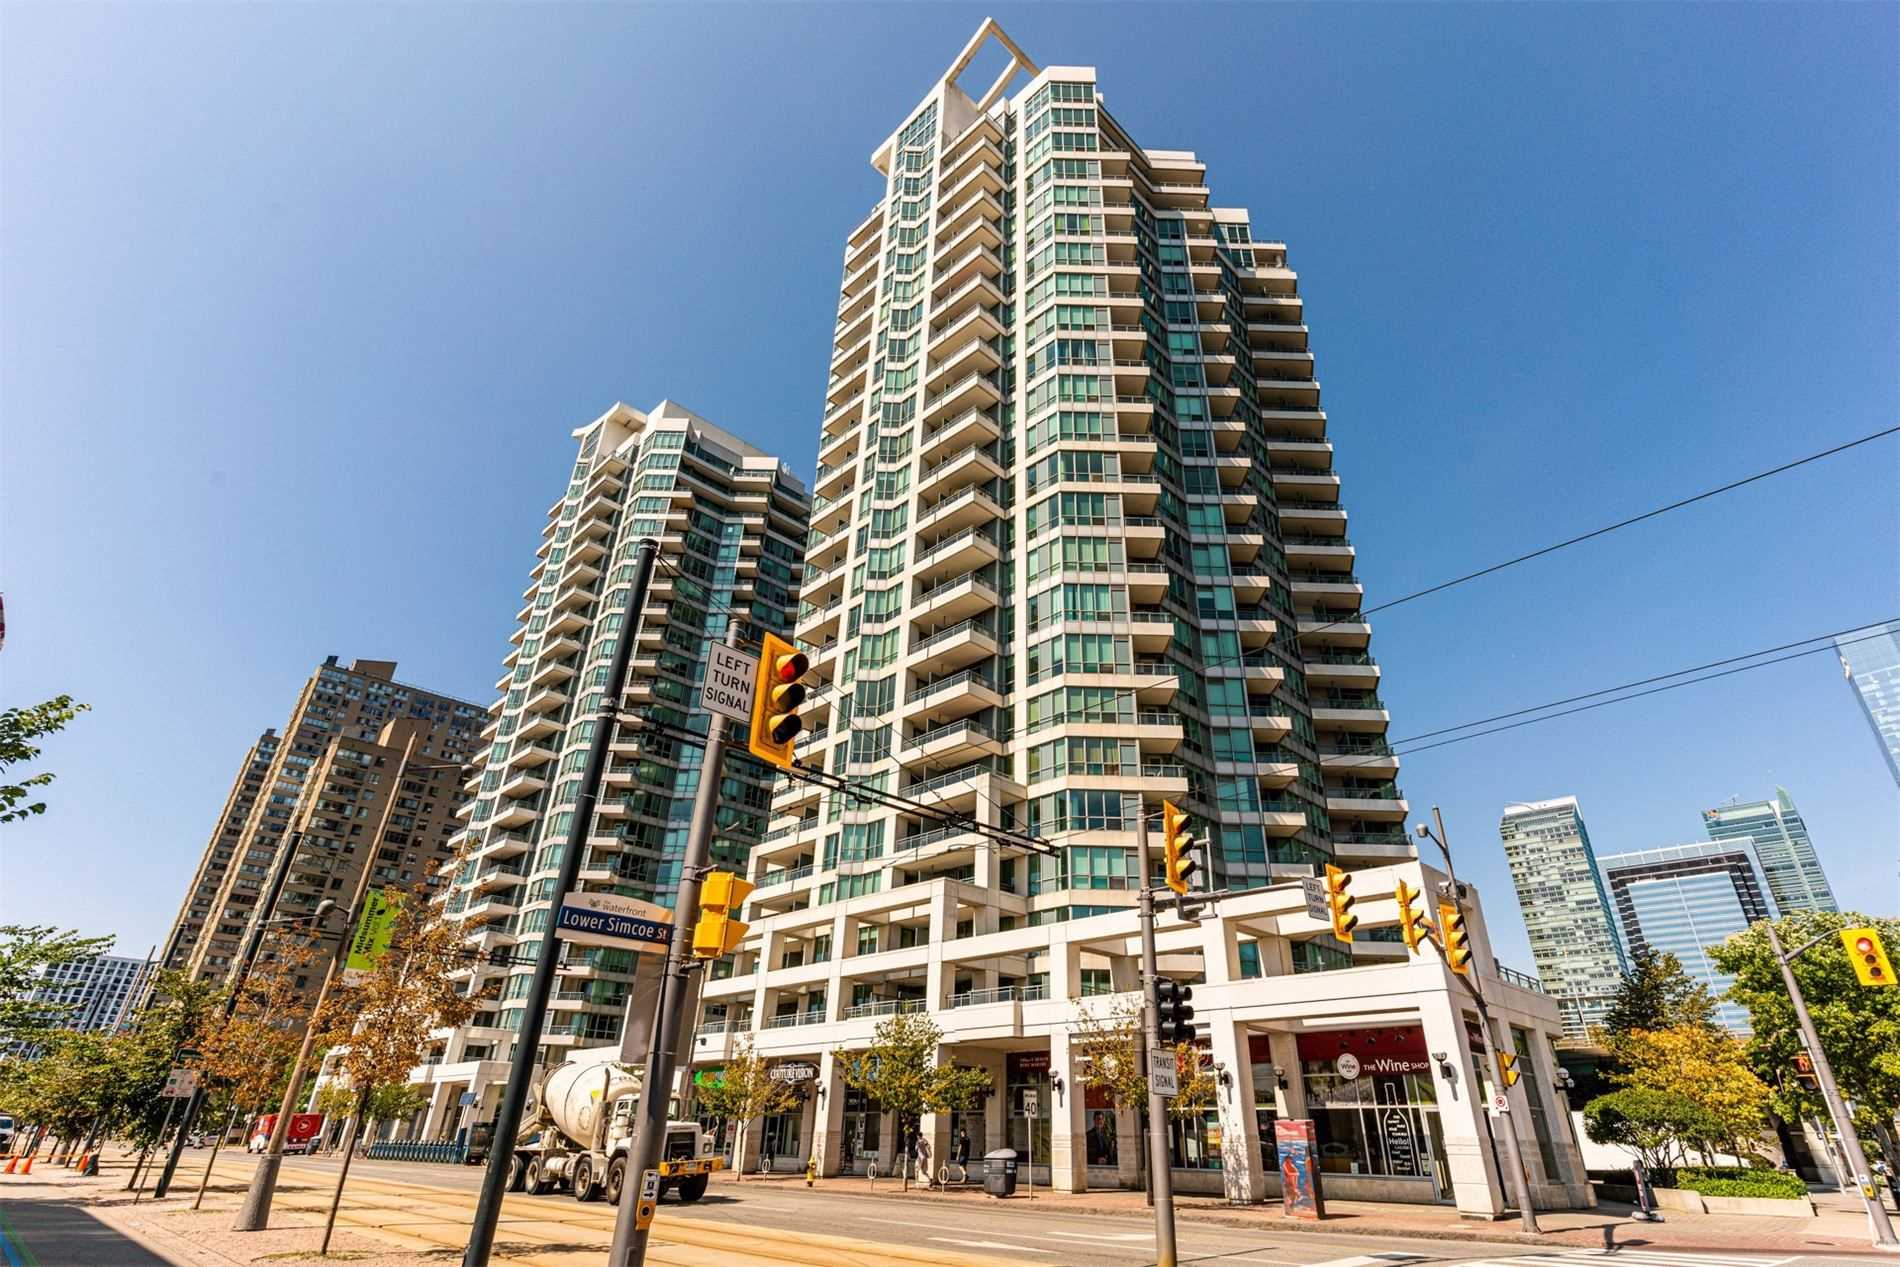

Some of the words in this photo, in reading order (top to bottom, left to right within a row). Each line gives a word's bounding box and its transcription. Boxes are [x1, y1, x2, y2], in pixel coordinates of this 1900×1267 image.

[716, 652, 751, 675] LEFT
[713, 668, 750, 694] TURN
[705, 686, 749, 714] SIGNAL
[1306, 881, 1320, 891] LEFT
[1308, 893, 1324, 904] TURN
[602, 904, 647, 918] waterfront
[354, 897, 379, 954] Midsummer
[563, 910, 605, 929] Lower
[607, 917, 654, 938] Simcoe
[657, 928, 667, 940] St
[1153, 1055, 1174, 1070] TRANSIT
[1363, 1063, 1376, 1071] THE
[1375, 1058, 1410, 1072] Wine
[1411, 1061, 1429, 1070] SHOP
[1155, 1074, 1174, 1088] SIGNAL
[1024, 1102, 1037, 1115] 40
